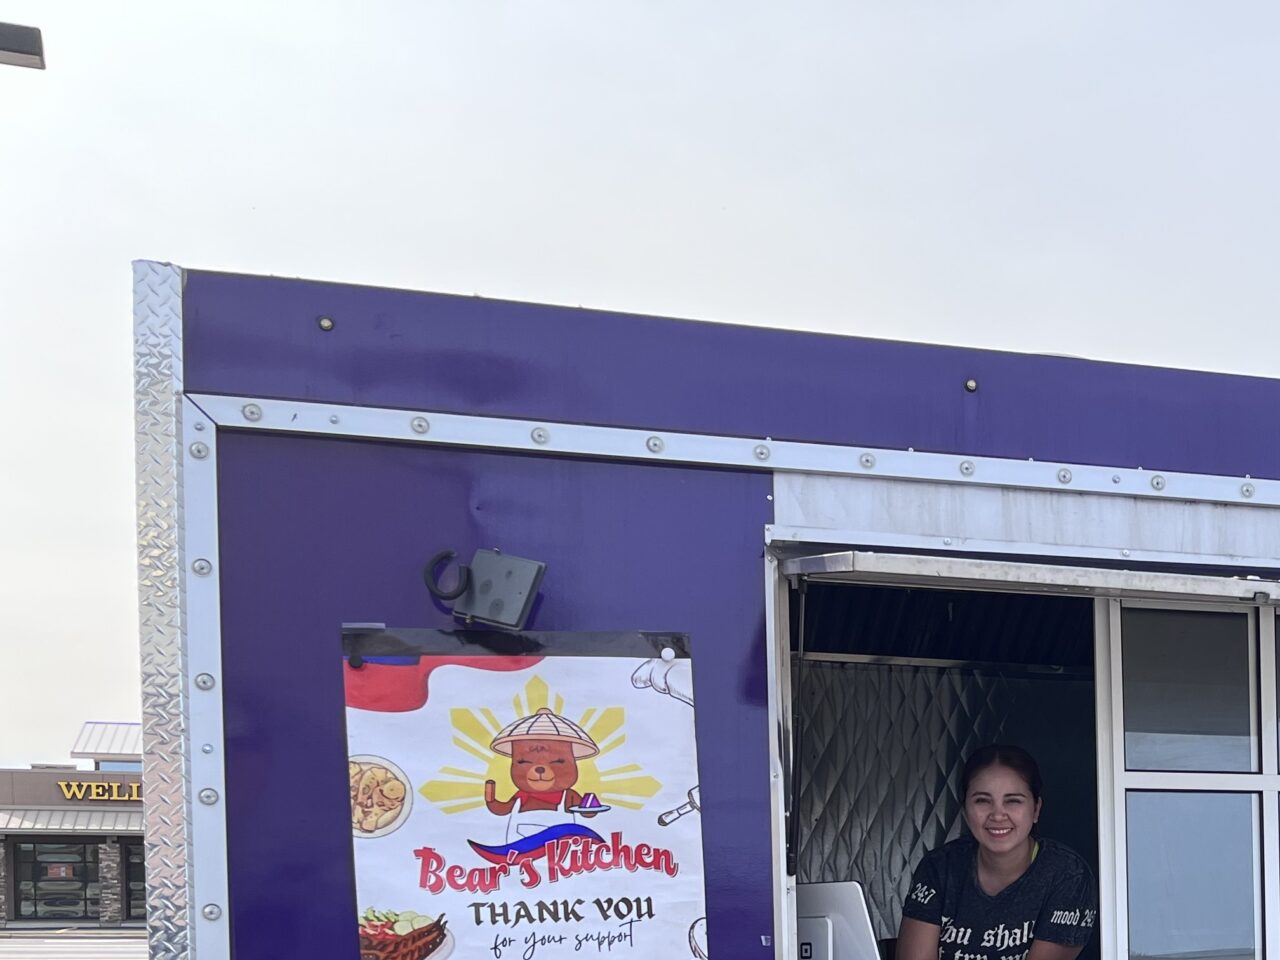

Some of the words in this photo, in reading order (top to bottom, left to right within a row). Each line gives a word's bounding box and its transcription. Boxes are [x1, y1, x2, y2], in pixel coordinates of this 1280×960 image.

[414, 846, 541, 895] Bear's
[545, 832, 679, 884] Kitchen
[467, 898, 586, 928] THANK
[592, 896, 656, 921] YOU
[1051, 909, 1080, 925] mood
[490, 934, 515, 959] for
[525, 931, 567, 960] your
[575, 919, 642, 952] support
